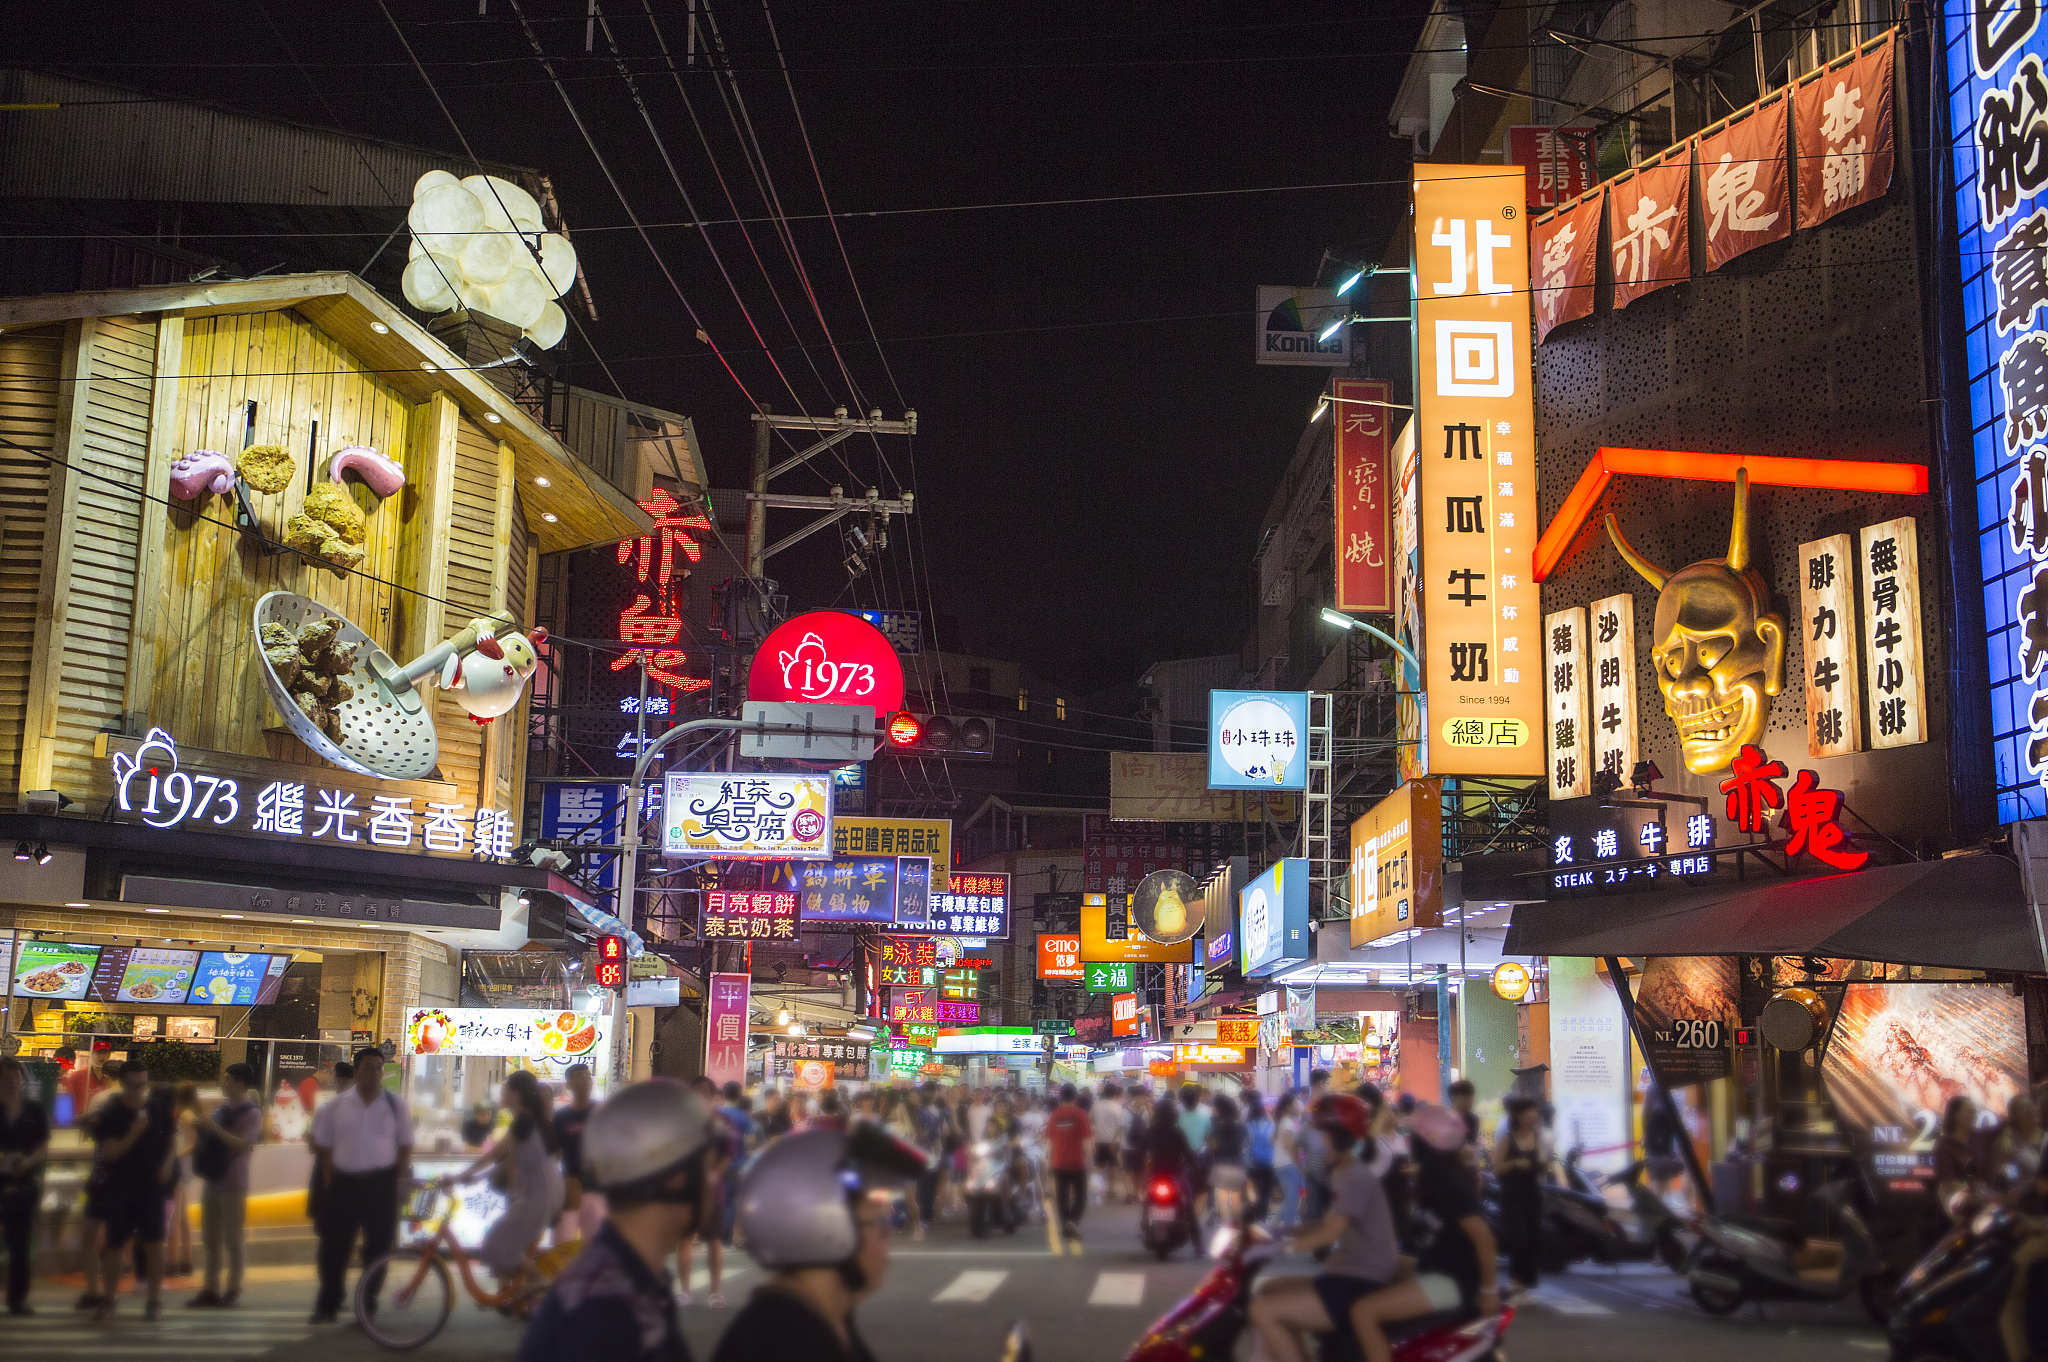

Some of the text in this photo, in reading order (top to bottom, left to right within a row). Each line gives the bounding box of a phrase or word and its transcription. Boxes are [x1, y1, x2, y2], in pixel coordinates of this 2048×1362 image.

[1612, 196, 1679, 286] 赤
[1705, 152, 1779, 243] 鬼
[1431, 217, 1515, 398] 北回
[1265, 333, 1343, 354] Konica
[1443, 422, 1489, 683] 木瓜牛奶
[610, 487, 711, 692] 赤鬼
[1808, 553, 1844, 747] 腓力牛排
[1870, 536, 1908, 737] 無骨牛小排
[800, 658, 876, 700] 1973
[1459, 695, 1510, 704] Since 1994
[1598, 611, 1625, 781] 沙朗牛排
[1232, 728, 1295, 748] 小珠珠
[1451, 719, 1520, 746] 總店
[141, 766, 240, 828] 1973
[1719, 744, 1868, 870] 赤鬼
[252, 780, 515, 859] 繼光香香雞
[700, 801, 788, 842] 臭豆腐
[834, 826, 940, 854] 益田體育用品社
[1554, 814, 1712, 865] 炙燒牛排
[772, 860, 887, 892] 八鍋聯軍
[1352, 836, 1377, 919] 北回
[1555, 871, 1594, 888] STEAK
[1605, 863, 1657, 883] ステーキ
[706, 892, 795, 915] 月亮蝦餅
[1107, 876, 1127, 938] 雜貨店
[705, 915, 794, 939] 泰式奶茶
[950, 916, 1001, 933] 專業維修
[1056, 954, 1076, 968] 依夢
[1091, 969, 1128, 988] 全福
[904, 991, 925, 1005] ET
[894, 1005, 934, 1021] 鹽水雞
[459, 1021, 533, 1042] 職人の果汁
[1012, 1038, 1032, 1049] 全家
[1655, 1019, 1719, 1049] NT. 260
[775, 1042, 867, 1060] 鋼化玻璃 專業包膜
[1873, 1126, 1908, 1143] NT.
